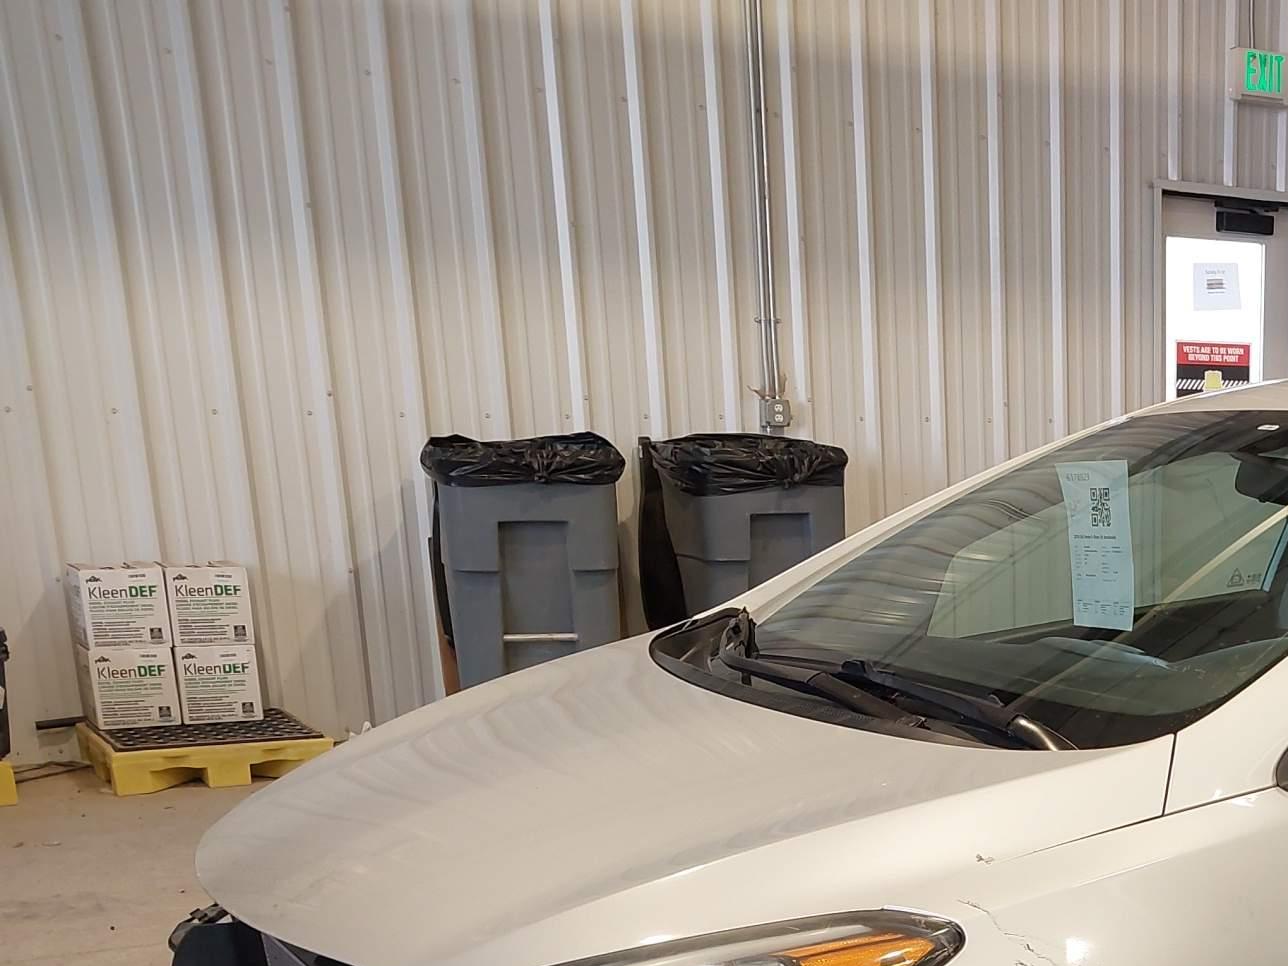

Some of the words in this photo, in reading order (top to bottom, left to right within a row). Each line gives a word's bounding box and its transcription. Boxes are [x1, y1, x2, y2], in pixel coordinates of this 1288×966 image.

[1246, 50, 1284, 93] EXIT
[1182, 345, 1199, 353] VESTS
[1212, 346, 1219, 354] TO
[88, 585, 157, 599] KleenDEF
[174, 584, 241, 597] KleenDEF
[97, 664, 166, 679] KleenDEF
[183, 662, 250, 675] KleenDEF
